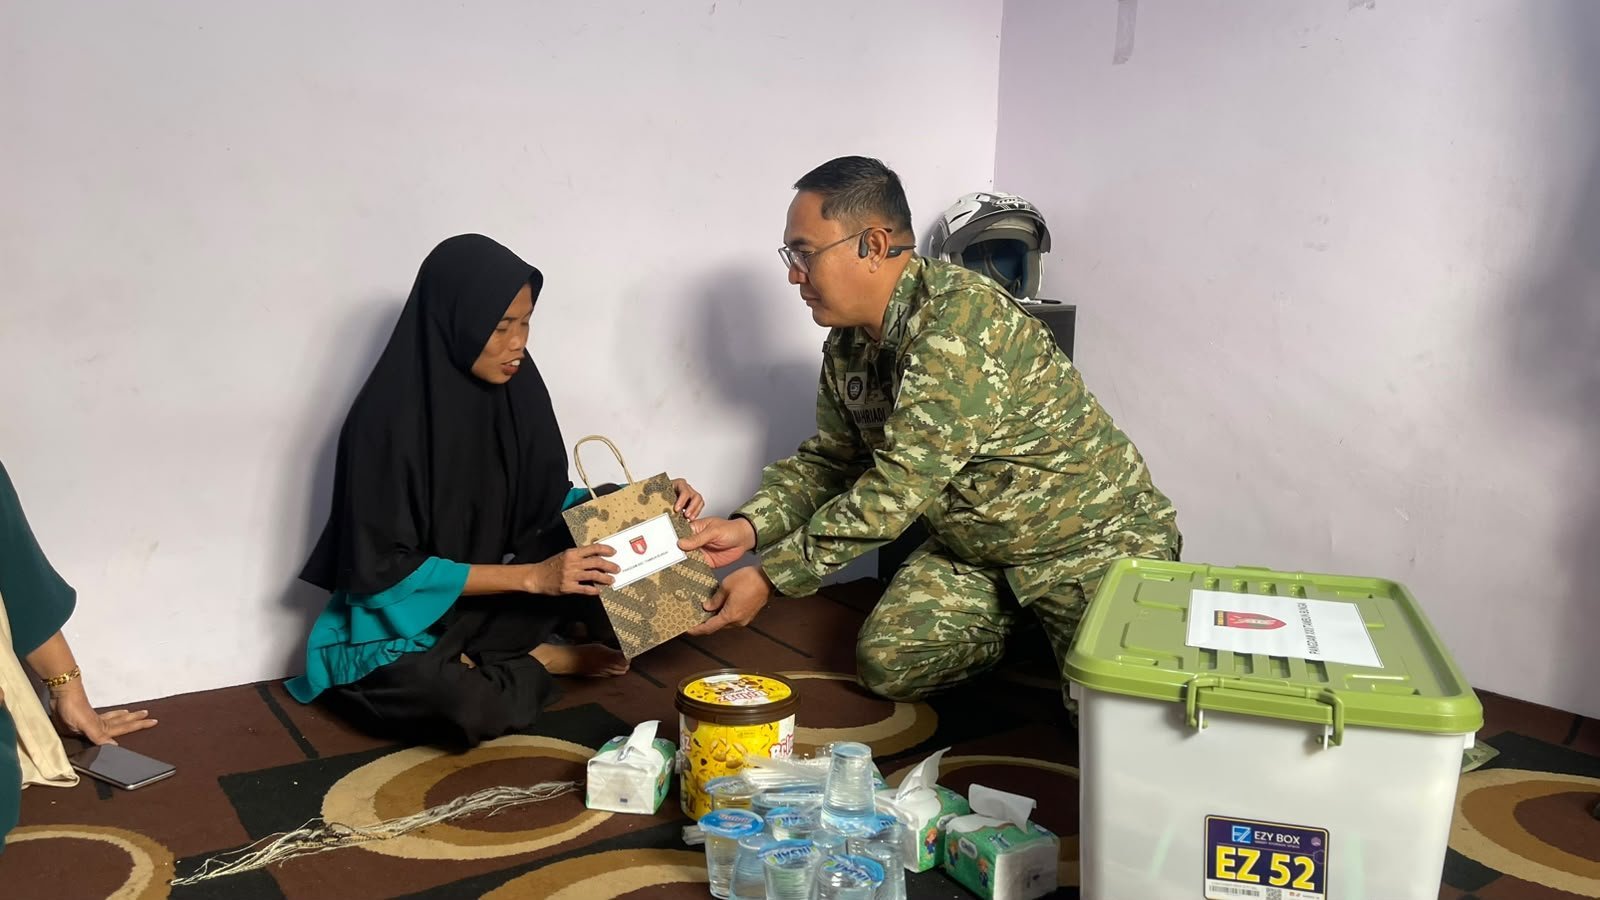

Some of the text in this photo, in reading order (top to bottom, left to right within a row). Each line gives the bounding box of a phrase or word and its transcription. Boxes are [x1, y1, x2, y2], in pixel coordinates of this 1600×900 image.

[1254, 830, 1274, 841] EZY
[1276, 833, 1301, 845] BOX
[1215, 845, 1315, 891] EZ 52
